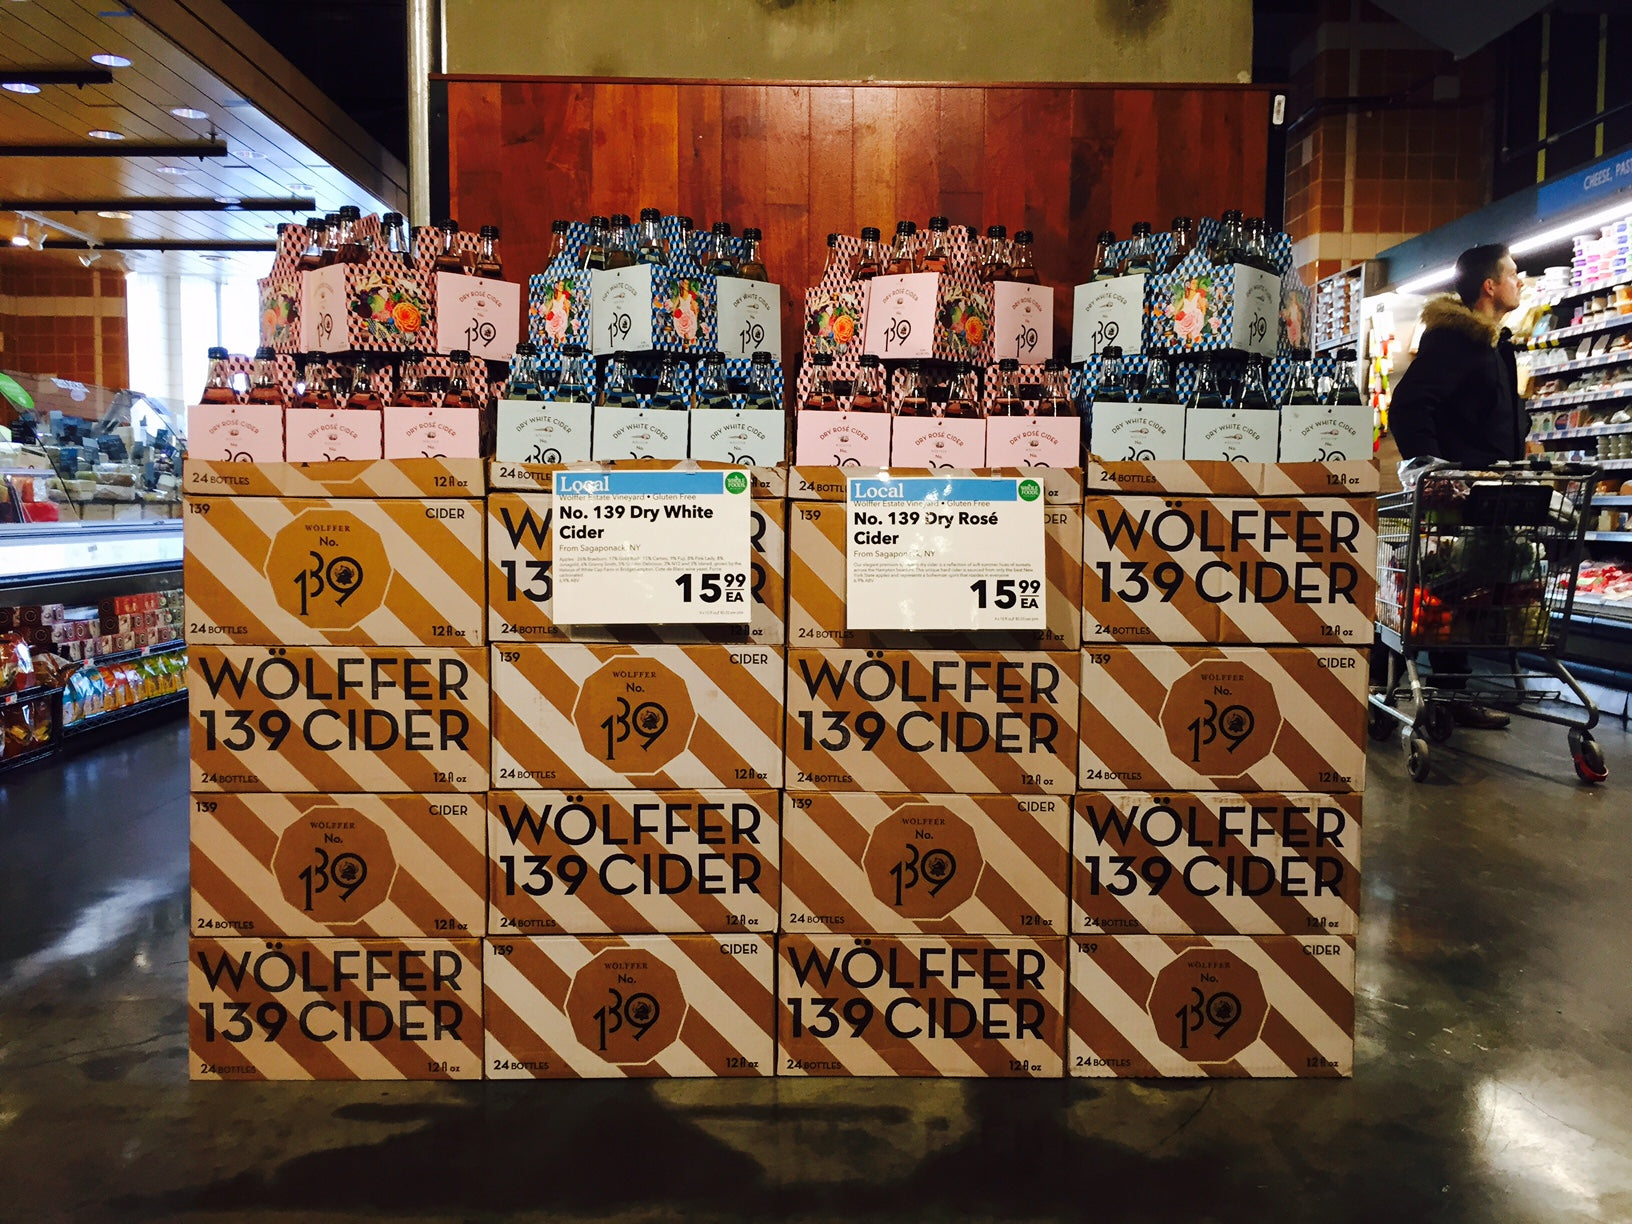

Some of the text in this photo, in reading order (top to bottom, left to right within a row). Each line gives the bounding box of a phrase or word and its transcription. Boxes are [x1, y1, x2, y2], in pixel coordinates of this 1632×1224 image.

[464, 317, 496, 351] 139
[608, 312, 632, 347] 139
[739, 320, 765, 353] 139
[883, 317, 911, 352] 139
[1015, 324, 1038, 358] 139
[192, 473, 250, 485] 24 BOTTLES
[560, 476, 609, 492] Local
[612, 494, 645, 502] Vineyard
[855, 483, 904, 498] Local
[189, 503, 465, 519] 139 CIDER
[560, 504, 713, 522] No. 139 Dry White
[800, 510, 821, 520] 139
[854, 512, 998, 529] No. 139 Dry Rosé
[1097, 500, 1360, 553] WÖLFFER
[559, 525, 605, 539] Cider
[854, 531, 899, 545] Cider
[319, 536, 339, 547] No.
[293, 551, 363, 616] 139
[675, 574, 746, 603] 15 99
[1096, 561, 1358, 604] 139 CIDER
[726, 592, 744, 602] EA
[970, 580, 1041, 609] 15 99
[1021, 598, 1039, 609] EA
[190, 623, 248, 635] 24 BOTTLES
[1095, 624, 1150, 635] 24 BOTTLES
[500, 652, 768, 665] 139 CIDER
[1090, 654, 1356, 669] 139 CIDER
[198, 648, 468, 700] WÖLFFER
[798, 650, 1060, 704] WÖLFFER
[626, 682, 645, 693] No.
[1214, 685, 1232, 696] No.
[200, 708, 470, 751] 139 CIDER
[600, 696, 668, 760] 139
[798, 711, 1059, 754] 139 CIDER
[1187, 700, 1255, 763] 139
[201, 773, 259, 784] 24 BOTTLES
[500, 768, 556, 779] 24 BOTTLES
[797, 772, 853, 784] 24 BOTTLES
[1086, 770, 1142, 780] 24 BOTTLES
[195, 802, 468, 816] 139 CIDER
[791, 798, 1055, 812] 139 CIDER
[499, 795, 761, 846] WÖLFFER
[1086, 796, 1346, 848] WÖLFFER
[324, 833, 344, 844] No.
[915, 829, 934, 840] No.
[298, 847, 367, 911] 139
[500, 853, 762, 896] 139 CIDER
[889, 843, 956, 906] 139
[1085, 855, 1344, 897] 139 CIDER
[197, 918, 254, 930] 24 BOTTLES
[500, 917, 556, 928] 24 BOTTLES
[790, 913, 845, 924] 24 BOTTLES
[1084, 917, 1139, 927] 24 BOTTLES
[493, 944, 758, 955] 139 CIDER
[1077, 943, 1340, 956] 139 CIDER
[197, 941, 463, 992] WÖLFFER
[787, 938, 1046, 990] WÖLFFER
[618, 973, 637, 984] No.
[1200, 973, 1219, 983] No.
[199, 1000, 463, 1043] 139 CIDER
[593, 988, 660, 1051] 139
[787, 997, 1046, 1040] 139 CIDER
[1175, 987, 1242, 1049] 139
[201, 1063, 256, 1074] 24 BOTTLES
[493, 1060, 549, 1070] 24 BOTTLES
[786, 1059, 842, 1070] 24 BOTTLES
[1076, 1056, 1131, 1067] 24 BOTTLES
